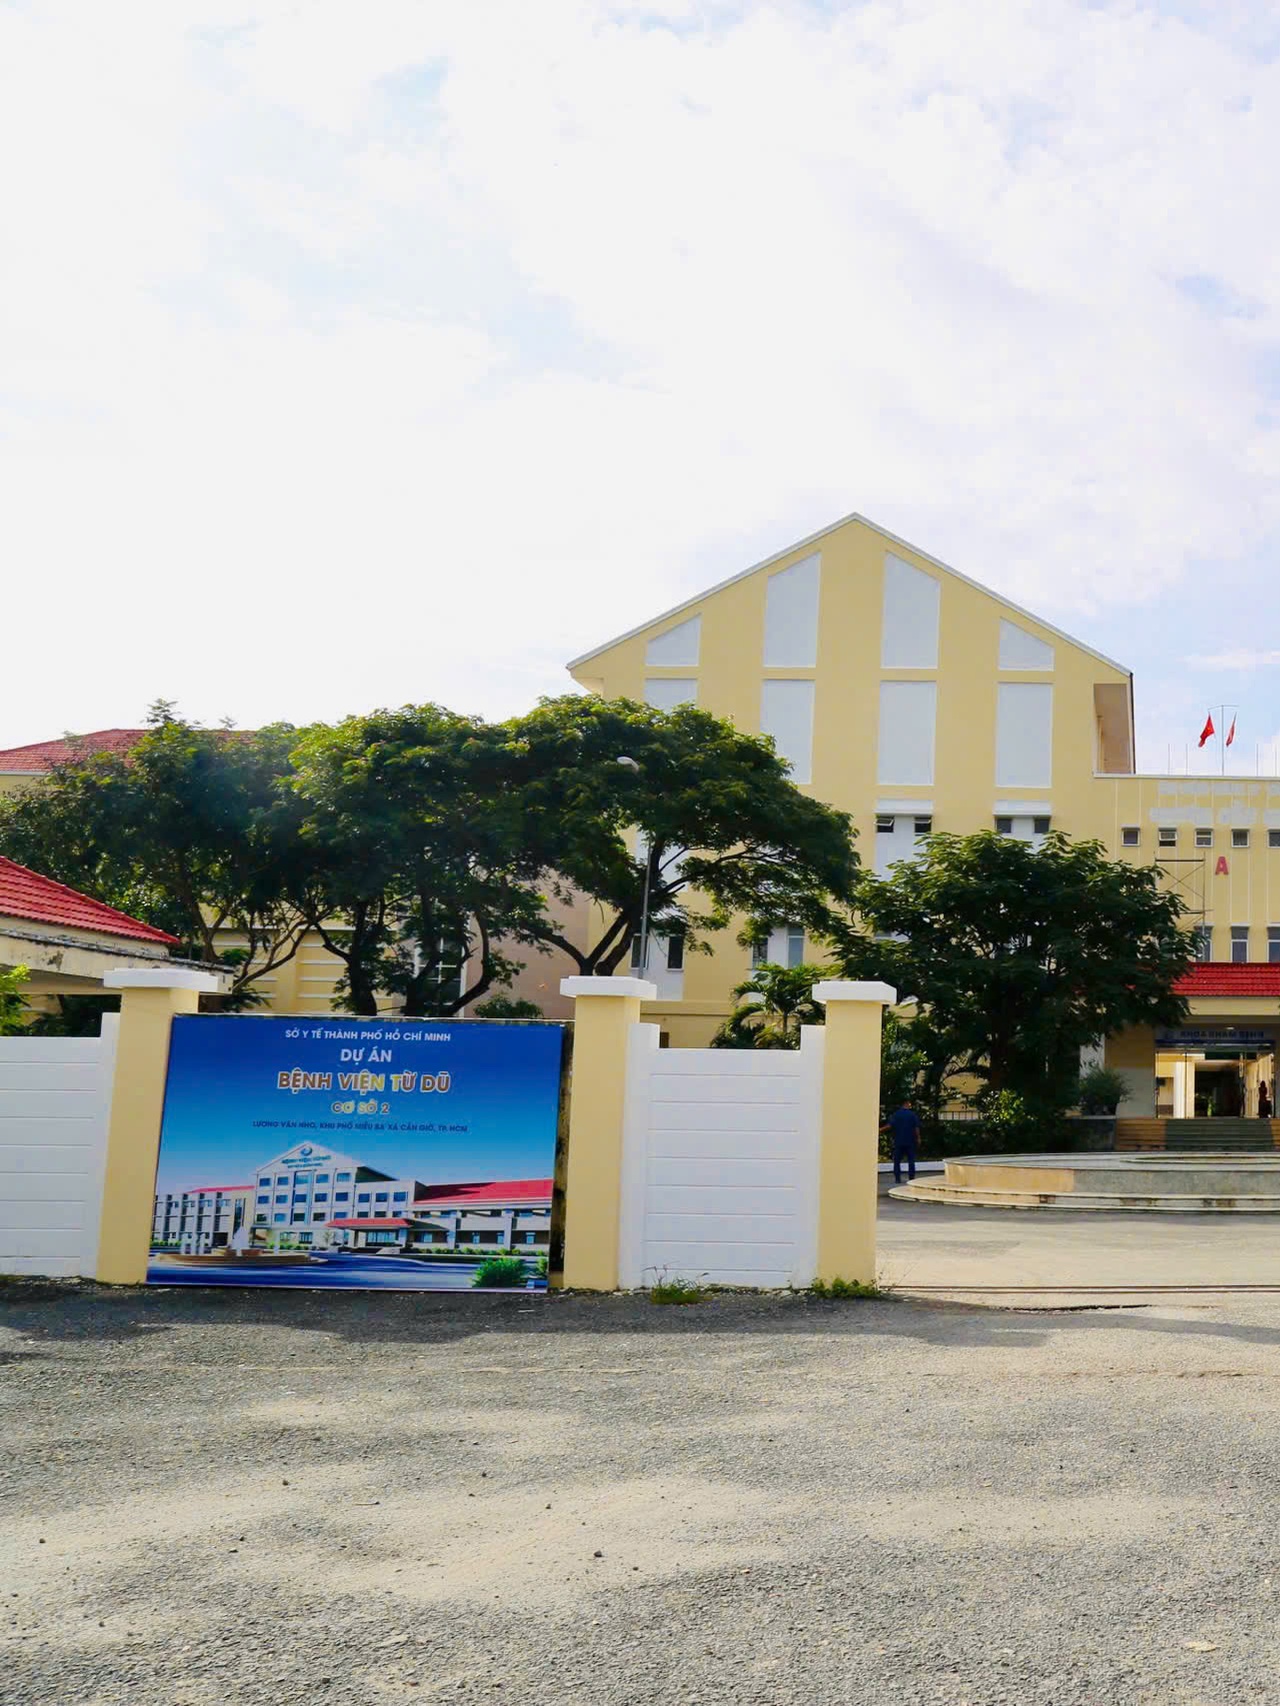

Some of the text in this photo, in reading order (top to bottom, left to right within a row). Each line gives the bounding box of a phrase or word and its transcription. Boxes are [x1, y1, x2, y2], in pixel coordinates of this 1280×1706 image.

[1215, 856, 1229, 876] A
[286, 1028, 299, 1038] SỞ
[302, 1030, 309, 1039] Y
[312, 1028, 323, 1039] TẾ
[324, 1030, 358, 1040] THÀNH
[361, 1029, 382, 1040] PHỐ
[403, 1031, 422, 1041] CHÍ
[424, 1033, 451, 1042] MINH
[340, 1046, 392, 1065] DỰ ÁN
[278, 1068, 450, 1095] BỆNH VIỆN TỪ DŨ
[332, 1099, 390, 1114] CƠ SỞ 2
